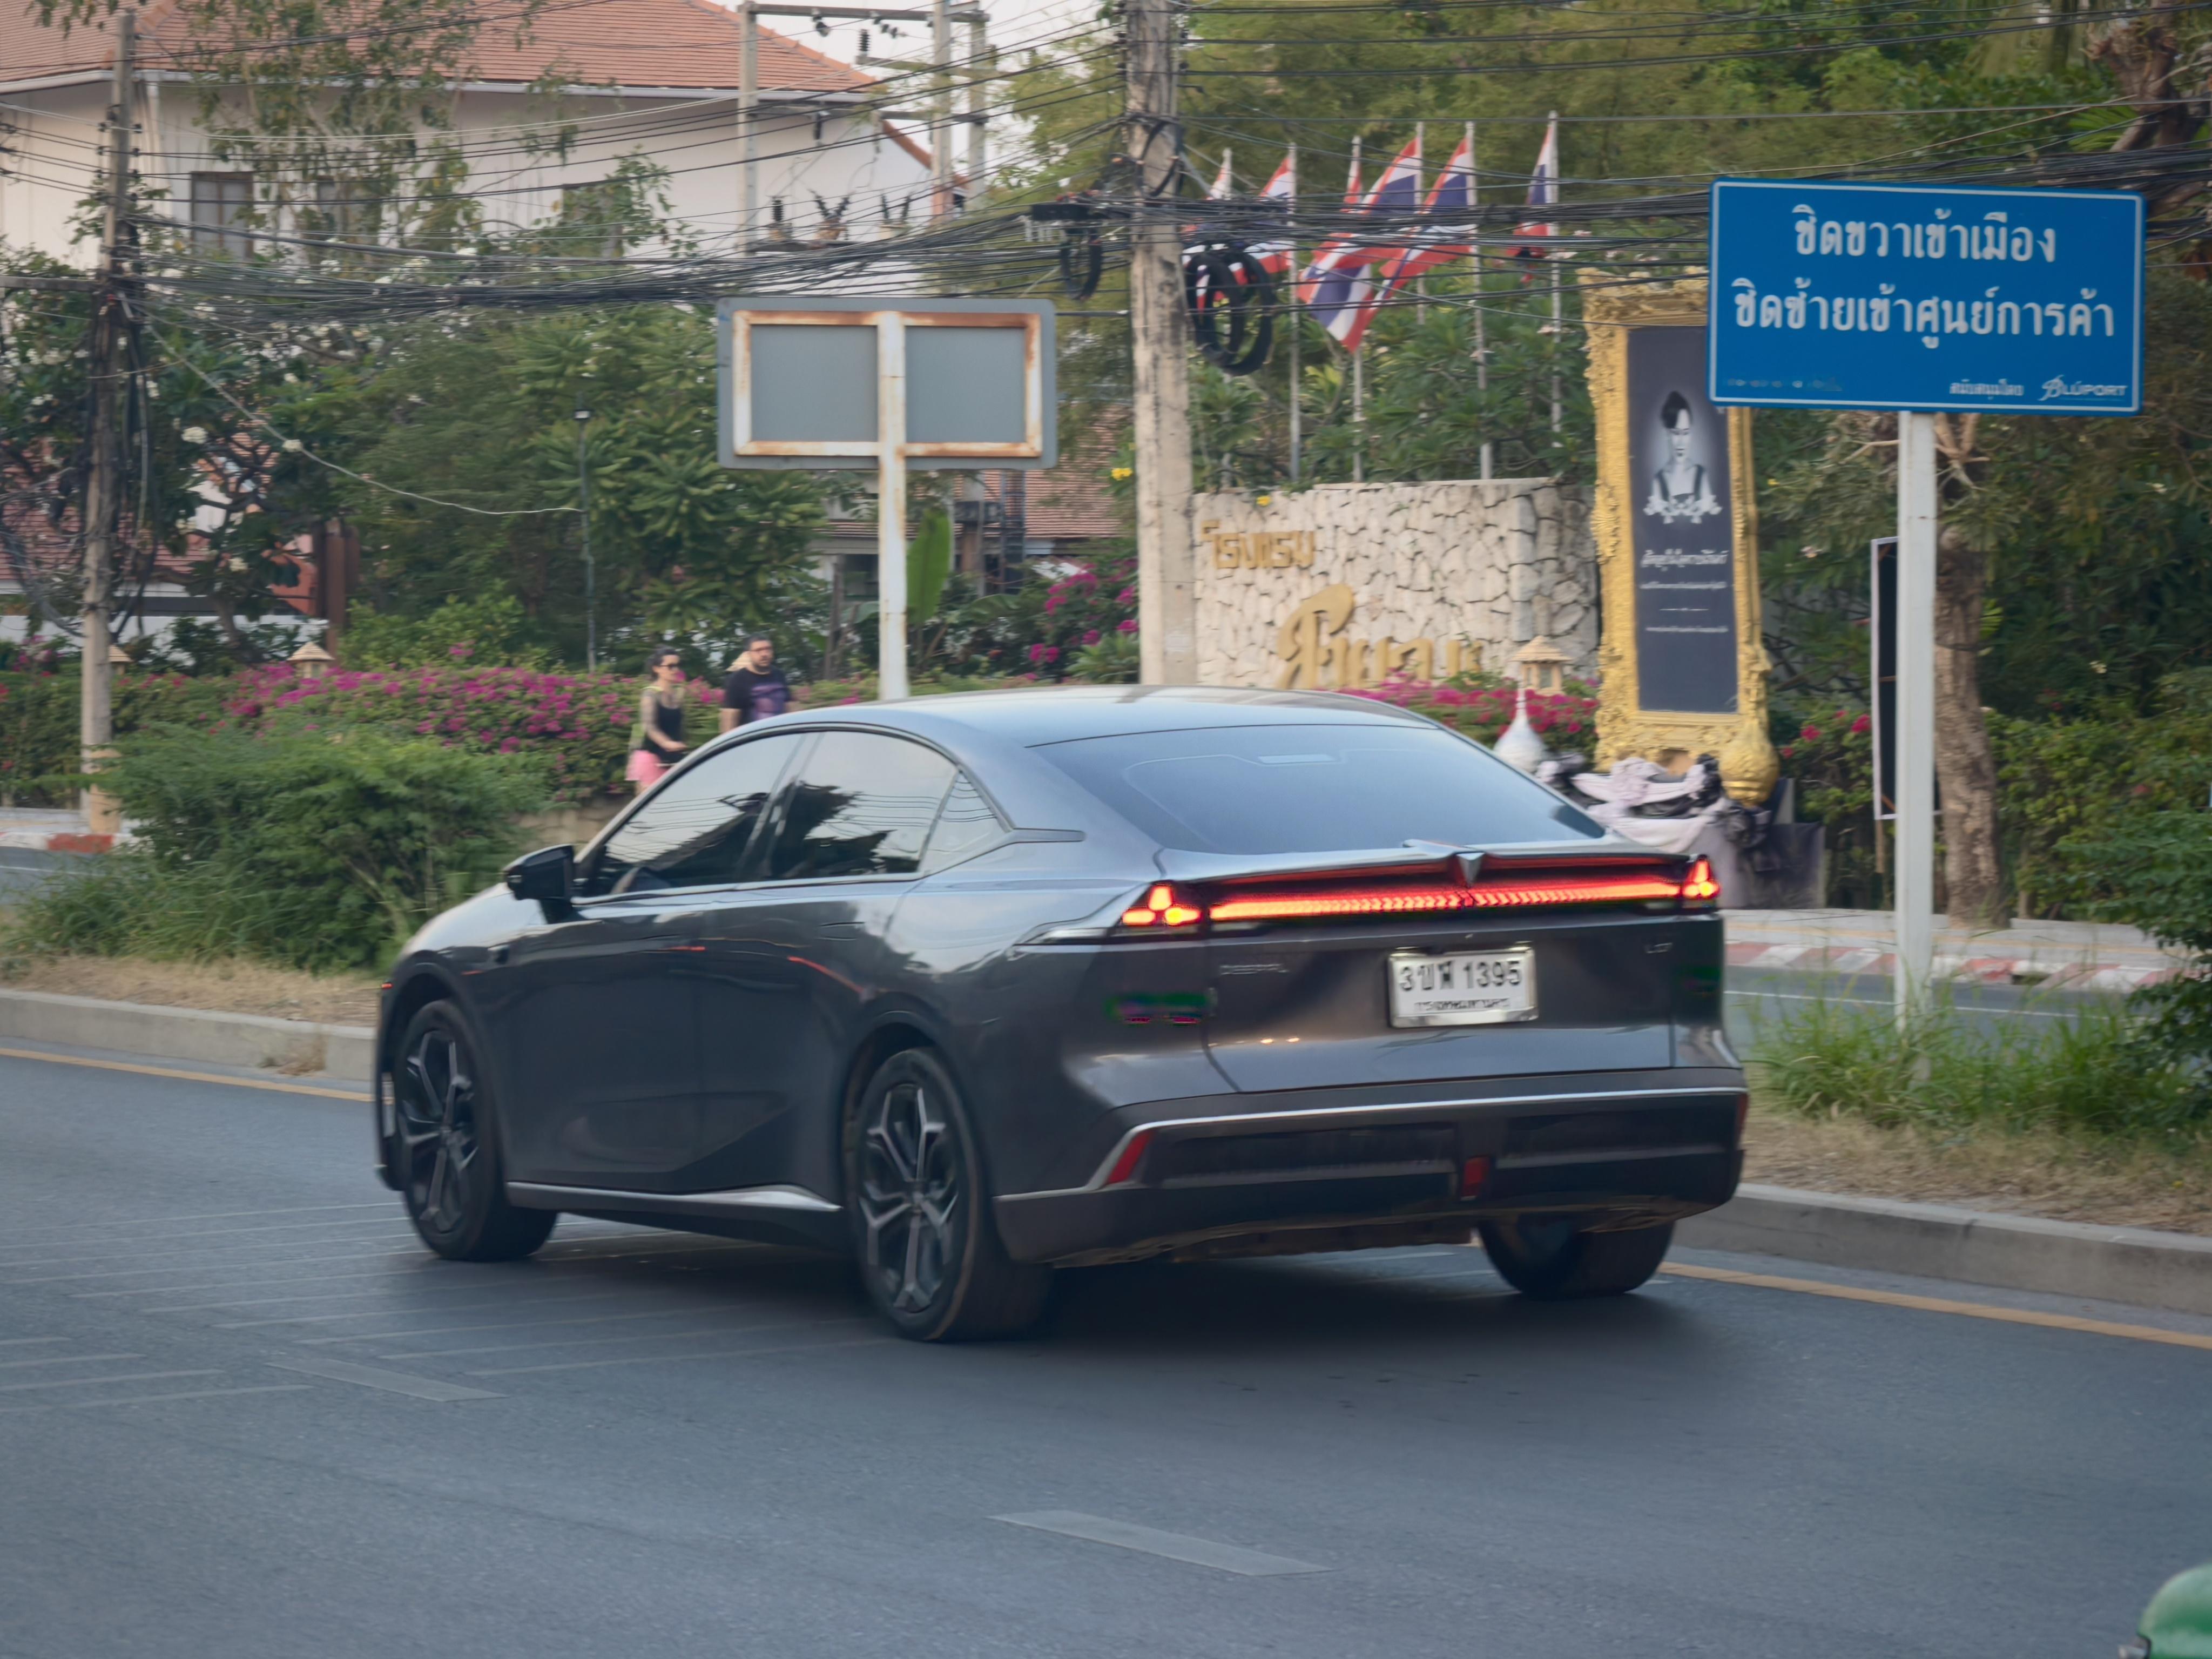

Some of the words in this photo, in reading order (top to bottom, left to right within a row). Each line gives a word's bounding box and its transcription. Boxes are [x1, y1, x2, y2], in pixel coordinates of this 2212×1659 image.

[1792, 204, 2056, 262] ชิดขวาเข้าเมือง
[1731, 277, 2115, 349] ชิดซ้ายเข้าศูนย์การค้า
[1464, 960, 1522, 988] 1395
